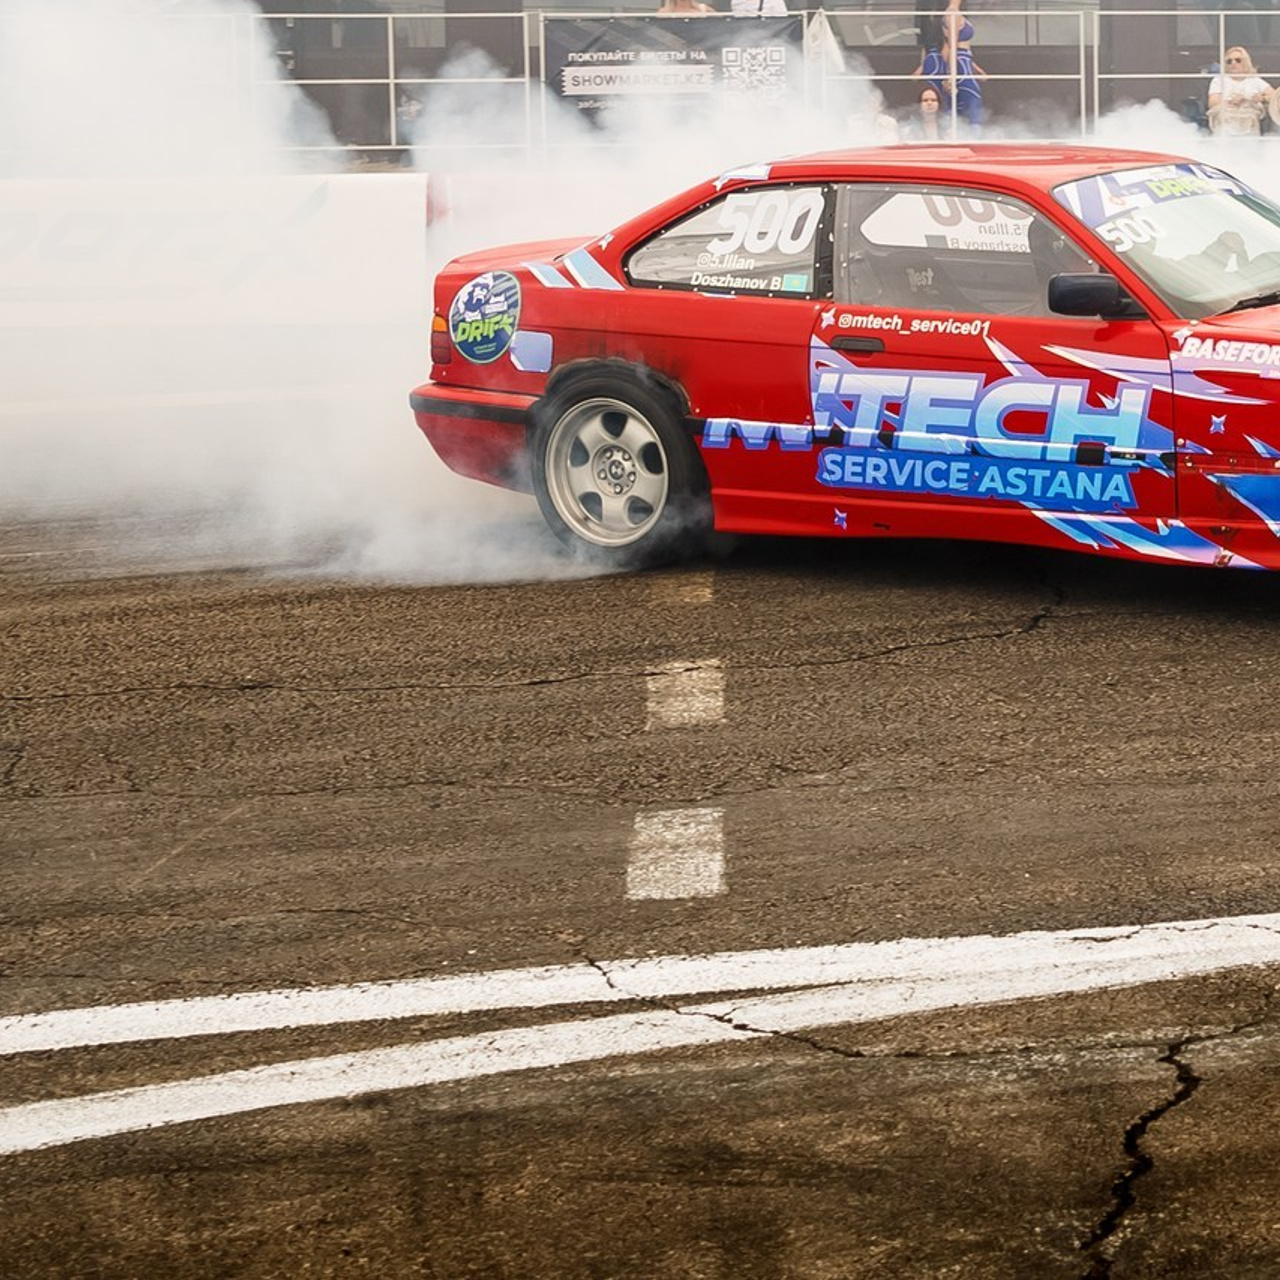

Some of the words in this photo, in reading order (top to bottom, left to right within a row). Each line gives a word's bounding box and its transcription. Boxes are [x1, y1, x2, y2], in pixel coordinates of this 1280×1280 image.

[567, 49, 637, 63] ПОКУПАЙТЕ
[689, 50, 708, 61] НА
[570, 73, 705, 88] SHOWMARKET.KZ
[705, 189, 826, 255] 500
[690, 272, 769, 290] Doszhanov
[822, 452, 969, 491] SERVICE
[977, 466, 1132, 503] ASTANA
